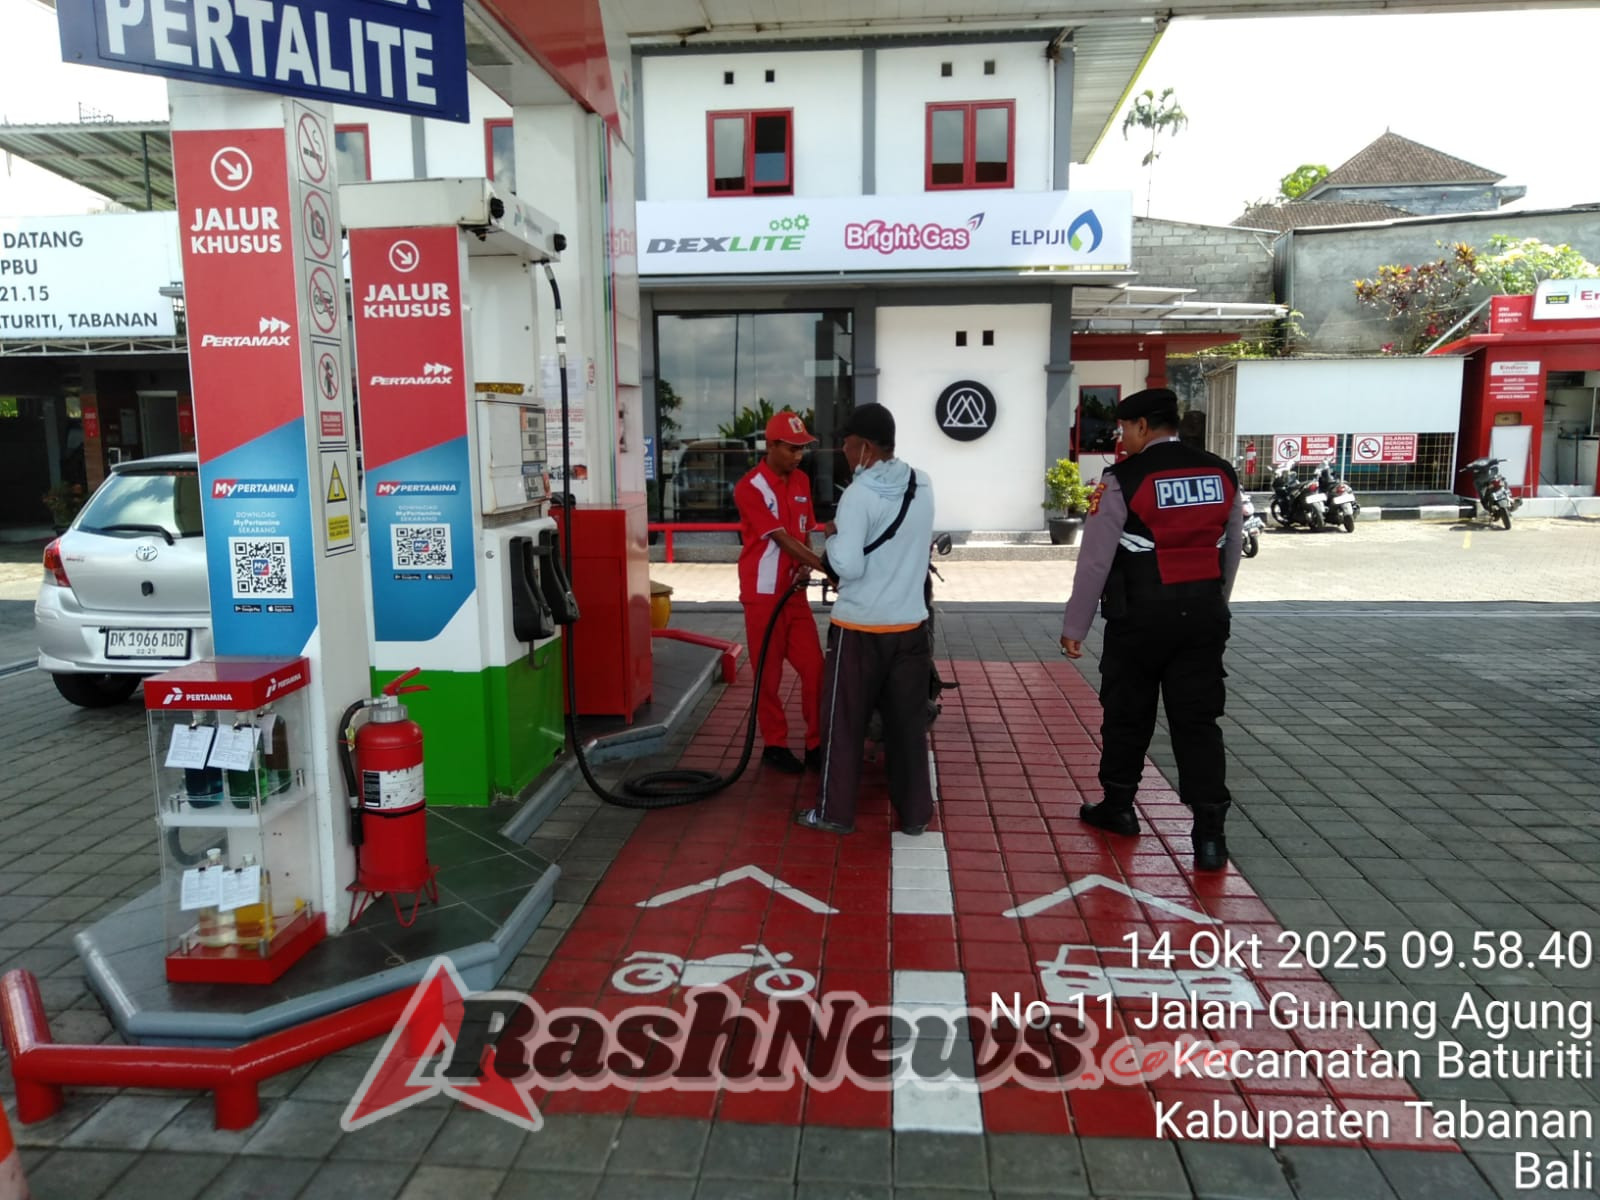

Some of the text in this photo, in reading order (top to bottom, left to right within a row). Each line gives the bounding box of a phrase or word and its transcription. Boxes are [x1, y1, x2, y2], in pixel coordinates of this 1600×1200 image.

[105, 0, 438, 105] PERTALITE
[190, 206, 280, 231] JALUR
[3, 230, 83, 248] DATANG
[191, 234, 282, 254] KHUSUS
[646, 235, 805, 254] DEXLITE
[845, 219, 970, 254] Bright Gas
[1011, 229, 1065, 246] ELPIJI
[363, 283, 451, 302] JALUR
[363, 303, 451, 318] KHUSUS
[0, 312, 158, 331] TURITI, TABANAN
[201, 334, 291, 347] PERTAMAX
[370, 375, 453, 386] PERTAMAX
[1158, 478, 1221, 505] POLISI
[110, 632, 185, 647] DK 1966 ADR
[186, 693, 233, 702] PERTAMINA
